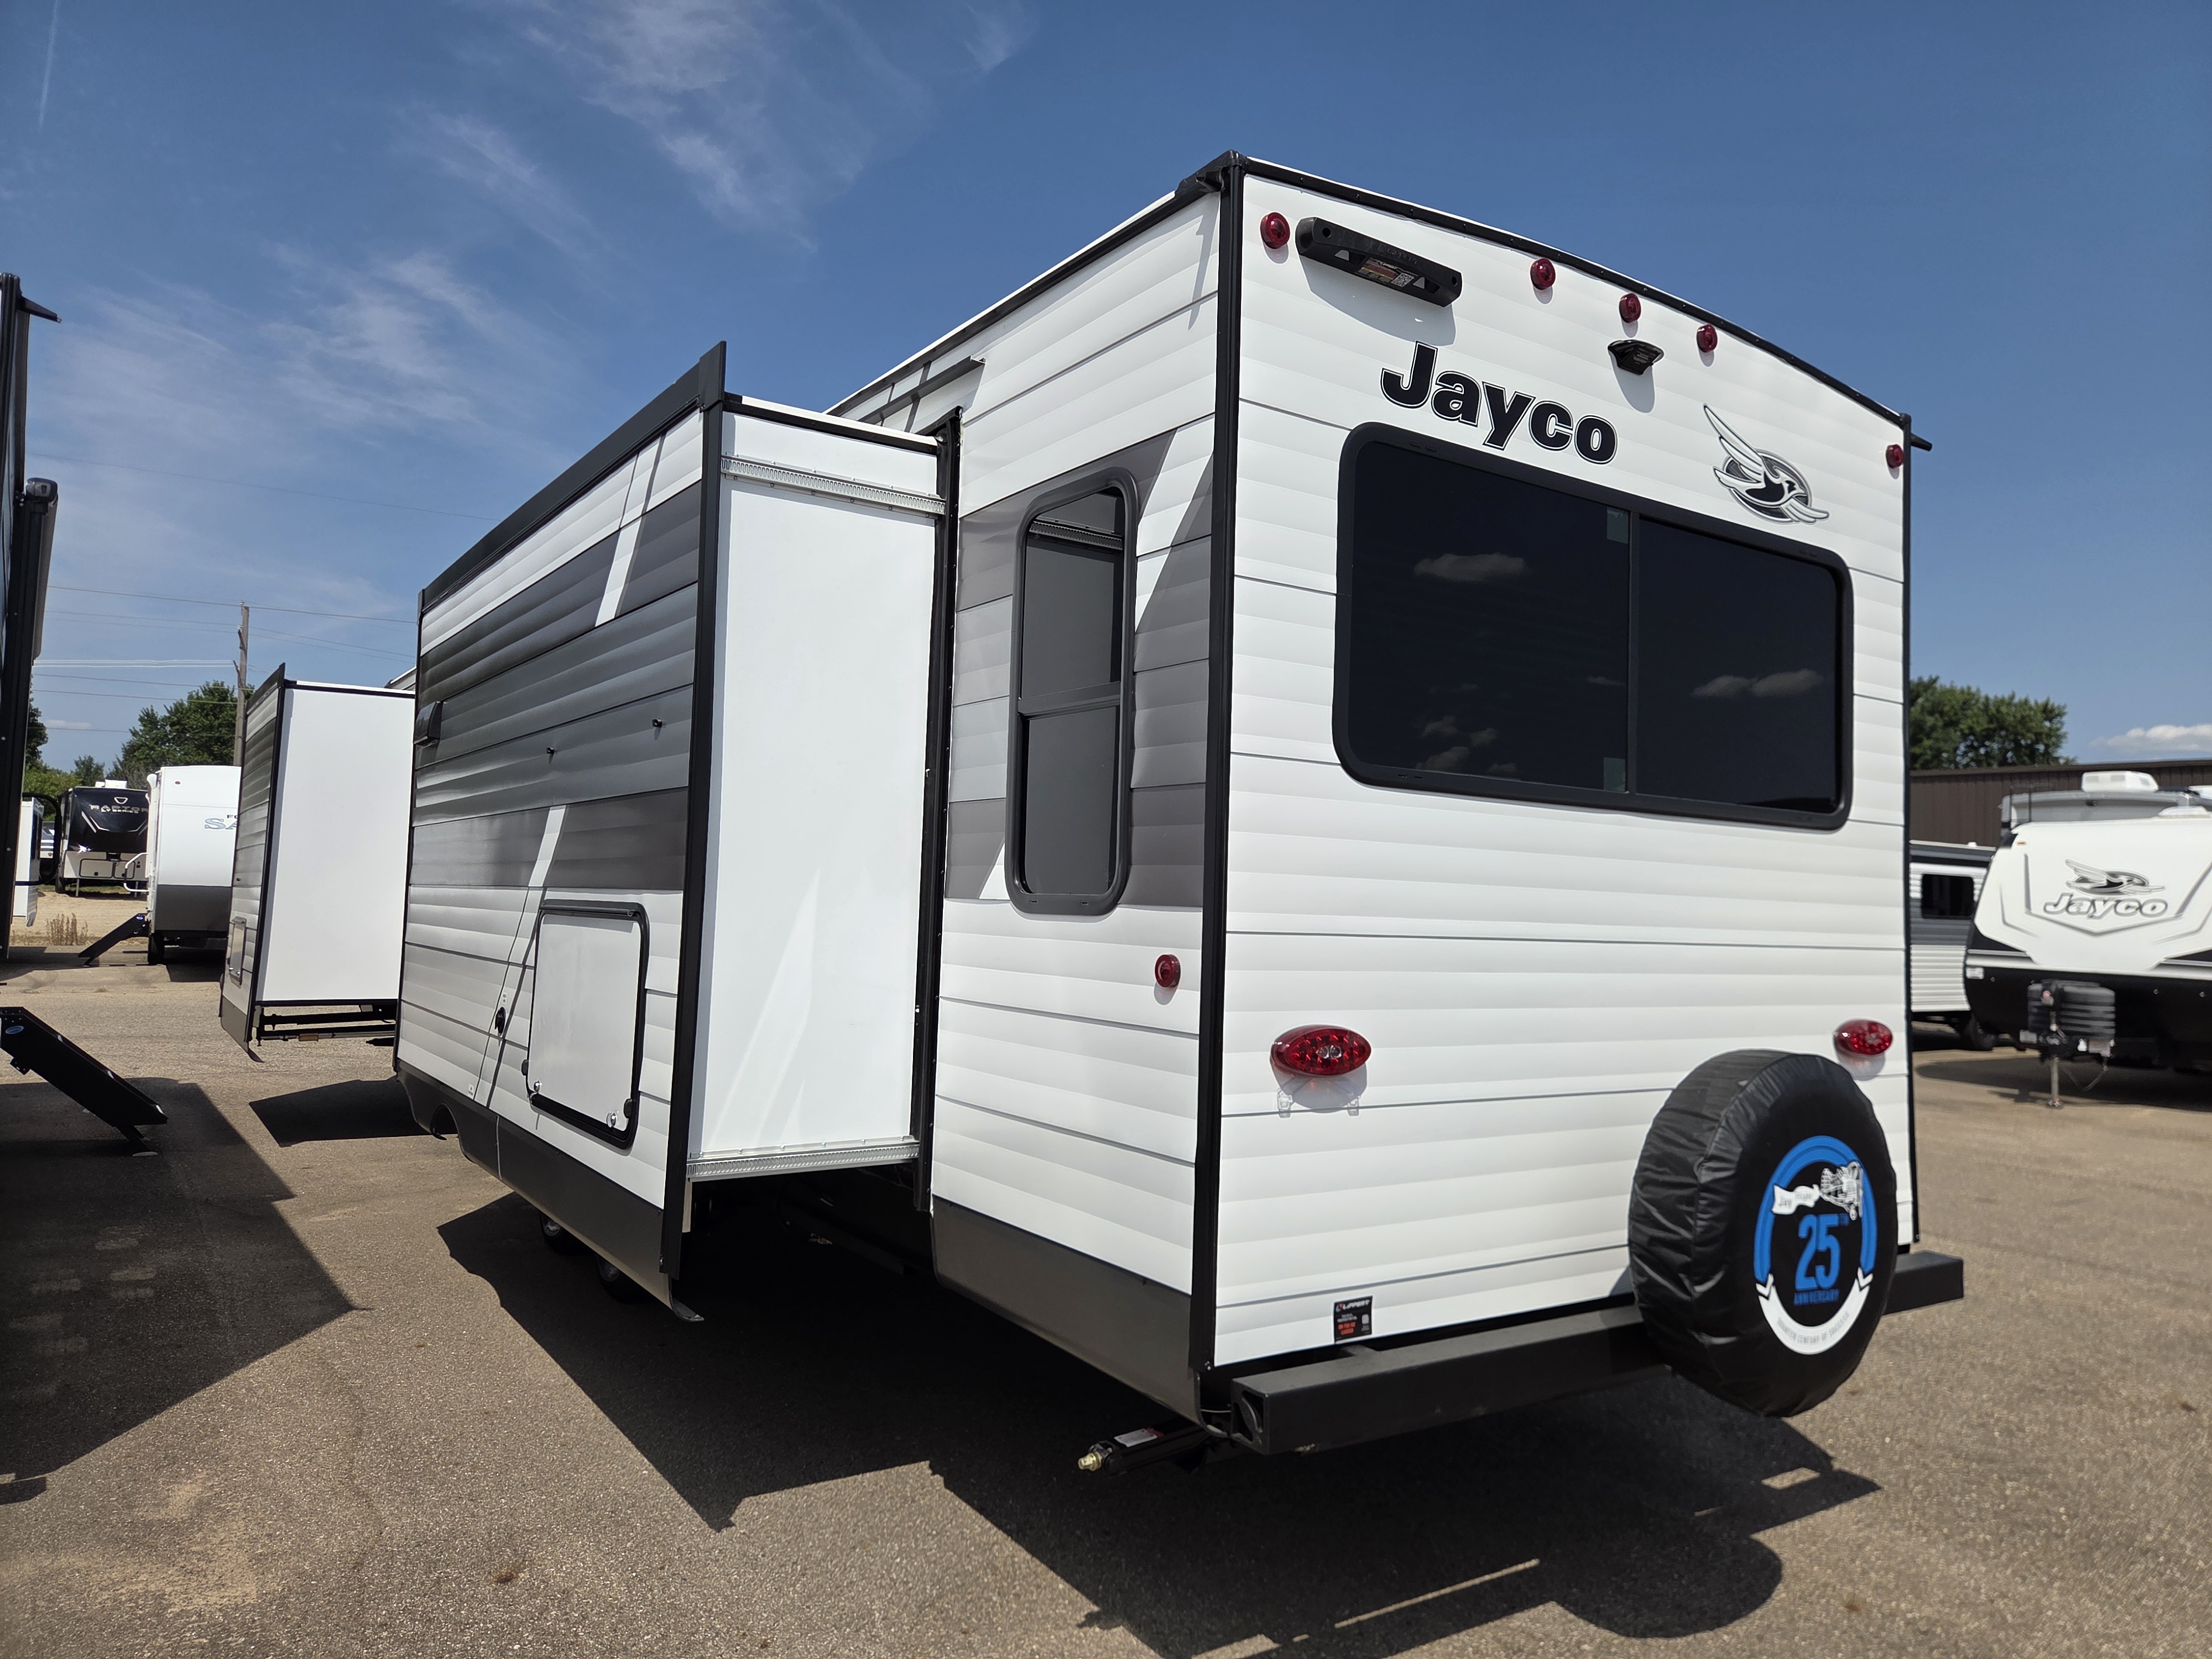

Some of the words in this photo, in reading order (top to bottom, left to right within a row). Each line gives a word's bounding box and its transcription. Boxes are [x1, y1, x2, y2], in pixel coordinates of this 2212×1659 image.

[1380, 340, 1618, 465] Jayco
[2043, 892, 2168, 920] Jayco
[1795, 1213, 1841, 1291] 25
